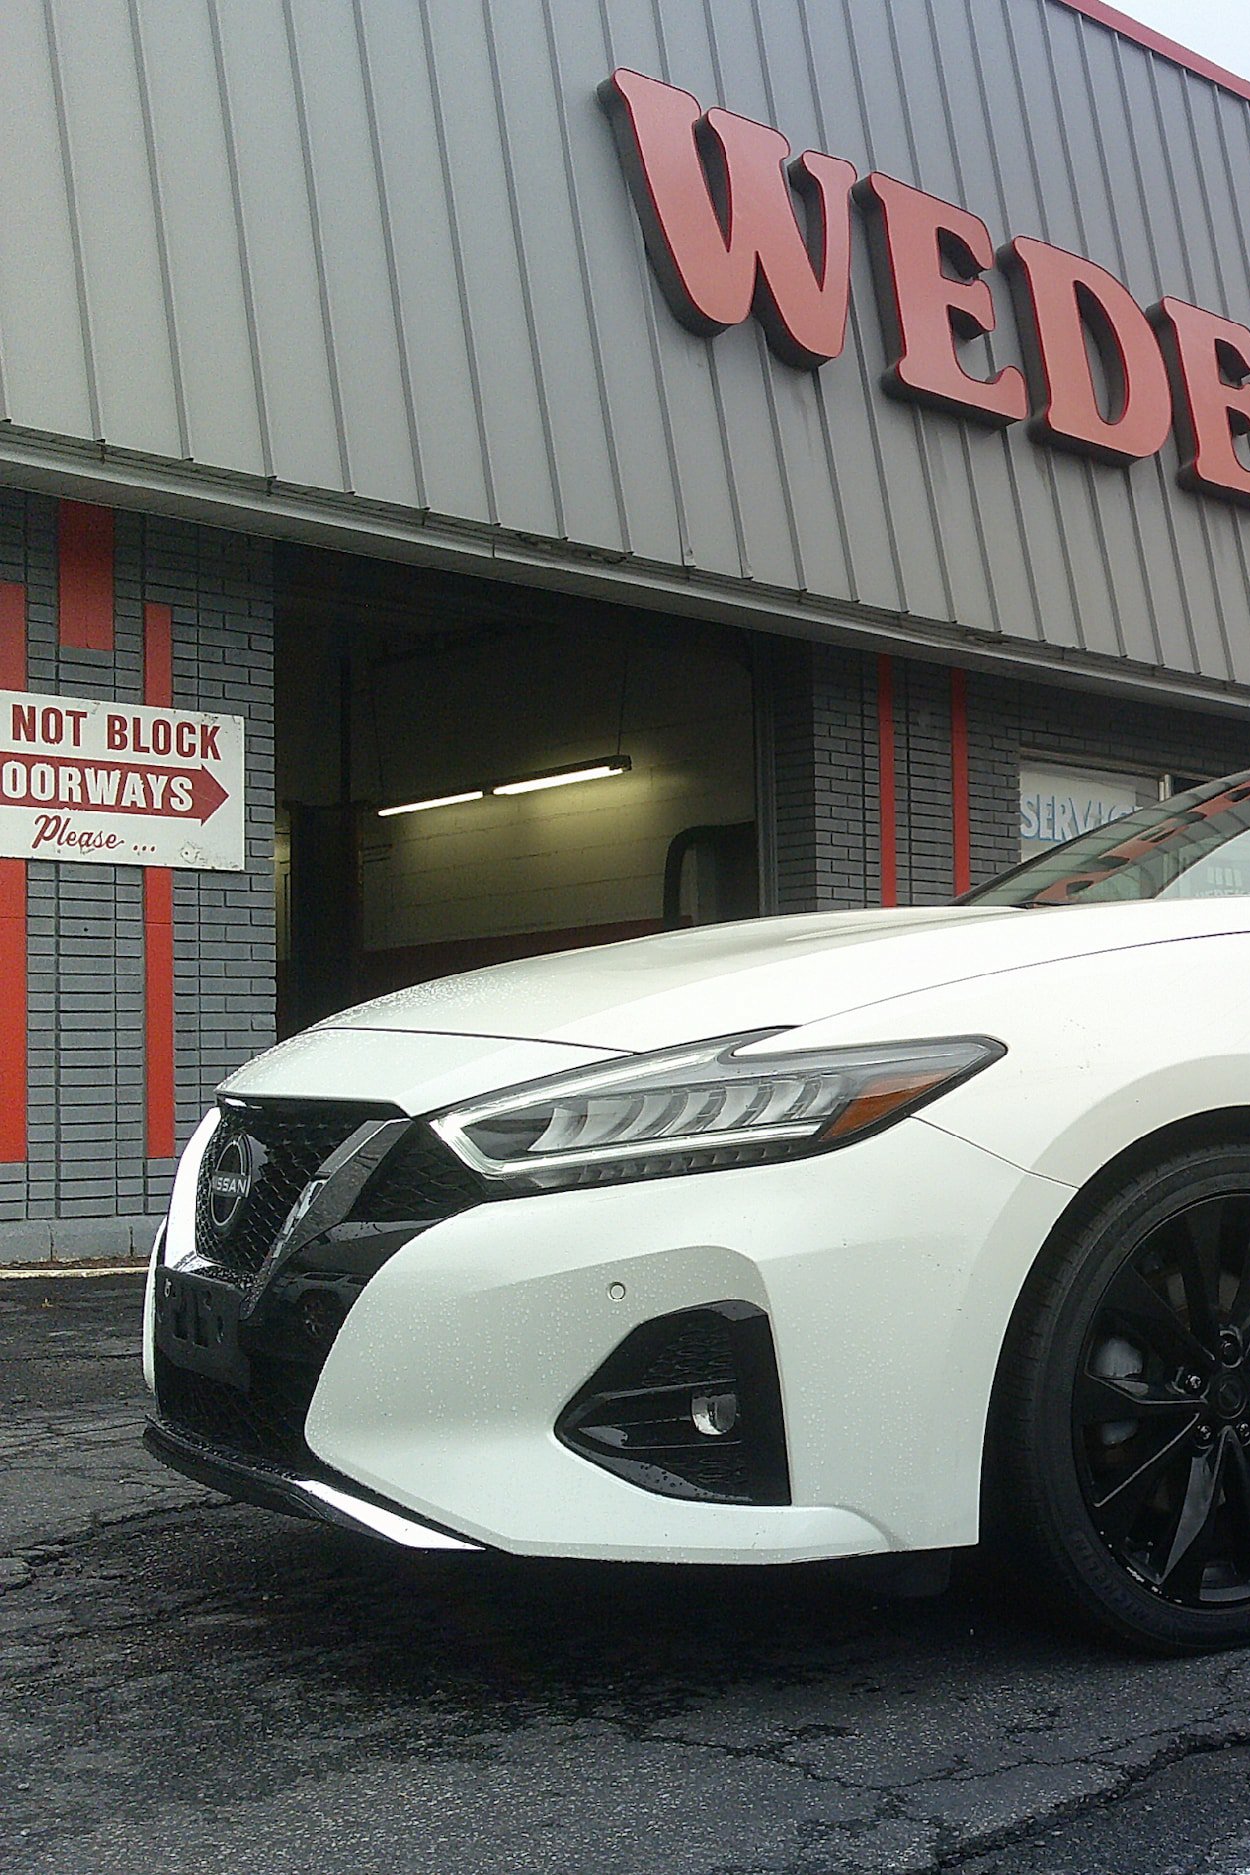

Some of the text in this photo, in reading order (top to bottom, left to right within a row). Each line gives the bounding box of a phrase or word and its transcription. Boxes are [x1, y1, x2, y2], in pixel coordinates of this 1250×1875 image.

[12, 703, 222, 761] NOT BLOCK
[2, 761, 194, 812] OORWAYS
[32, 814, 125, 850] Please
[1019, 794, 1143, 842] SERVI
